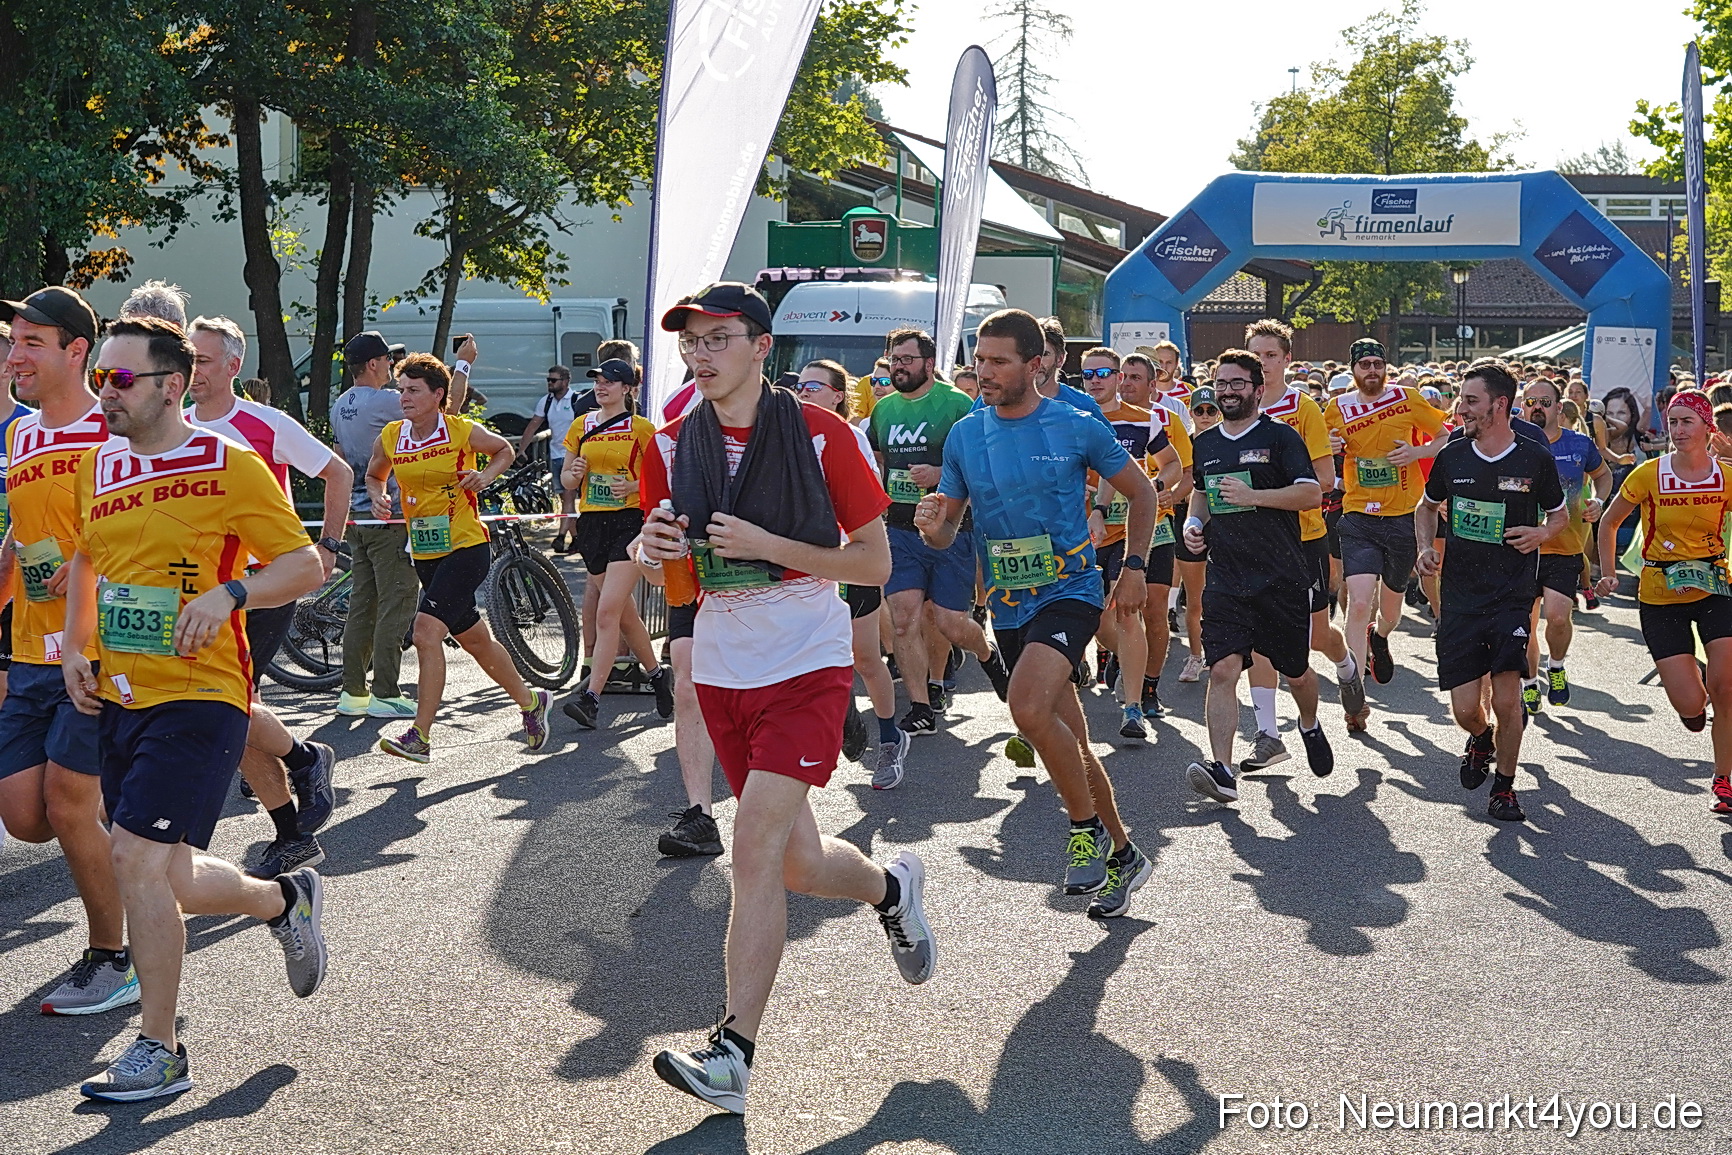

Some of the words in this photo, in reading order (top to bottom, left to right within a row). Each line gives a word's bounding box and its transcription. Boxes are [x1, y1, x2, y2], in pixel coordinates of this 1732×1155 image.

[1381, 197, 1414, 205] Fischer
[1356, 214, 1454, 233] firmenlauf
[1356, 233, 1396, 241] neumarkt
[1164, 244, 1217, 257] Fischer
[782, 310, 827, 321] abavent
[1346, 417, 1375, 436] MAX
[1377, 404, 1412, 421] BÖGL
[608, 434, 634, 442] BÖGL
[393, 456, 419, 465] MAX
[422, 447, 453, 459] BÖGL
[7, 462, 46, 493] MAX
[52, 453, 82, 476] BÖ
[1365, 468, 1388, 479] 804
[592, 485, 613, 497] 160
[893, 481, 919, 493] 1453
[90, 491, 144, 523] MAX
[153, 479, 226, 503] BÖGL
[1659, 497, 1689, 507] MAX
[1693, 494, 1723, 506] BÖGL
[1462, 513, 1489, 529] 421
[1494, 519, 1502, 538] 2022
[418, 529, 440, 542] 815
[696, 556, 706, 578] RUN
[999, 553, 1043, 573] 1914
[1043, 554, 1054, 577] 2022
[1021, 571, 1045, 580] Jochen
[1678, 569, 1705, 580] 816
[106, 606, 161, 632] 1633
[127, 631, 163, 641] Sebastian
[163, 615, 173, 646] 2022
